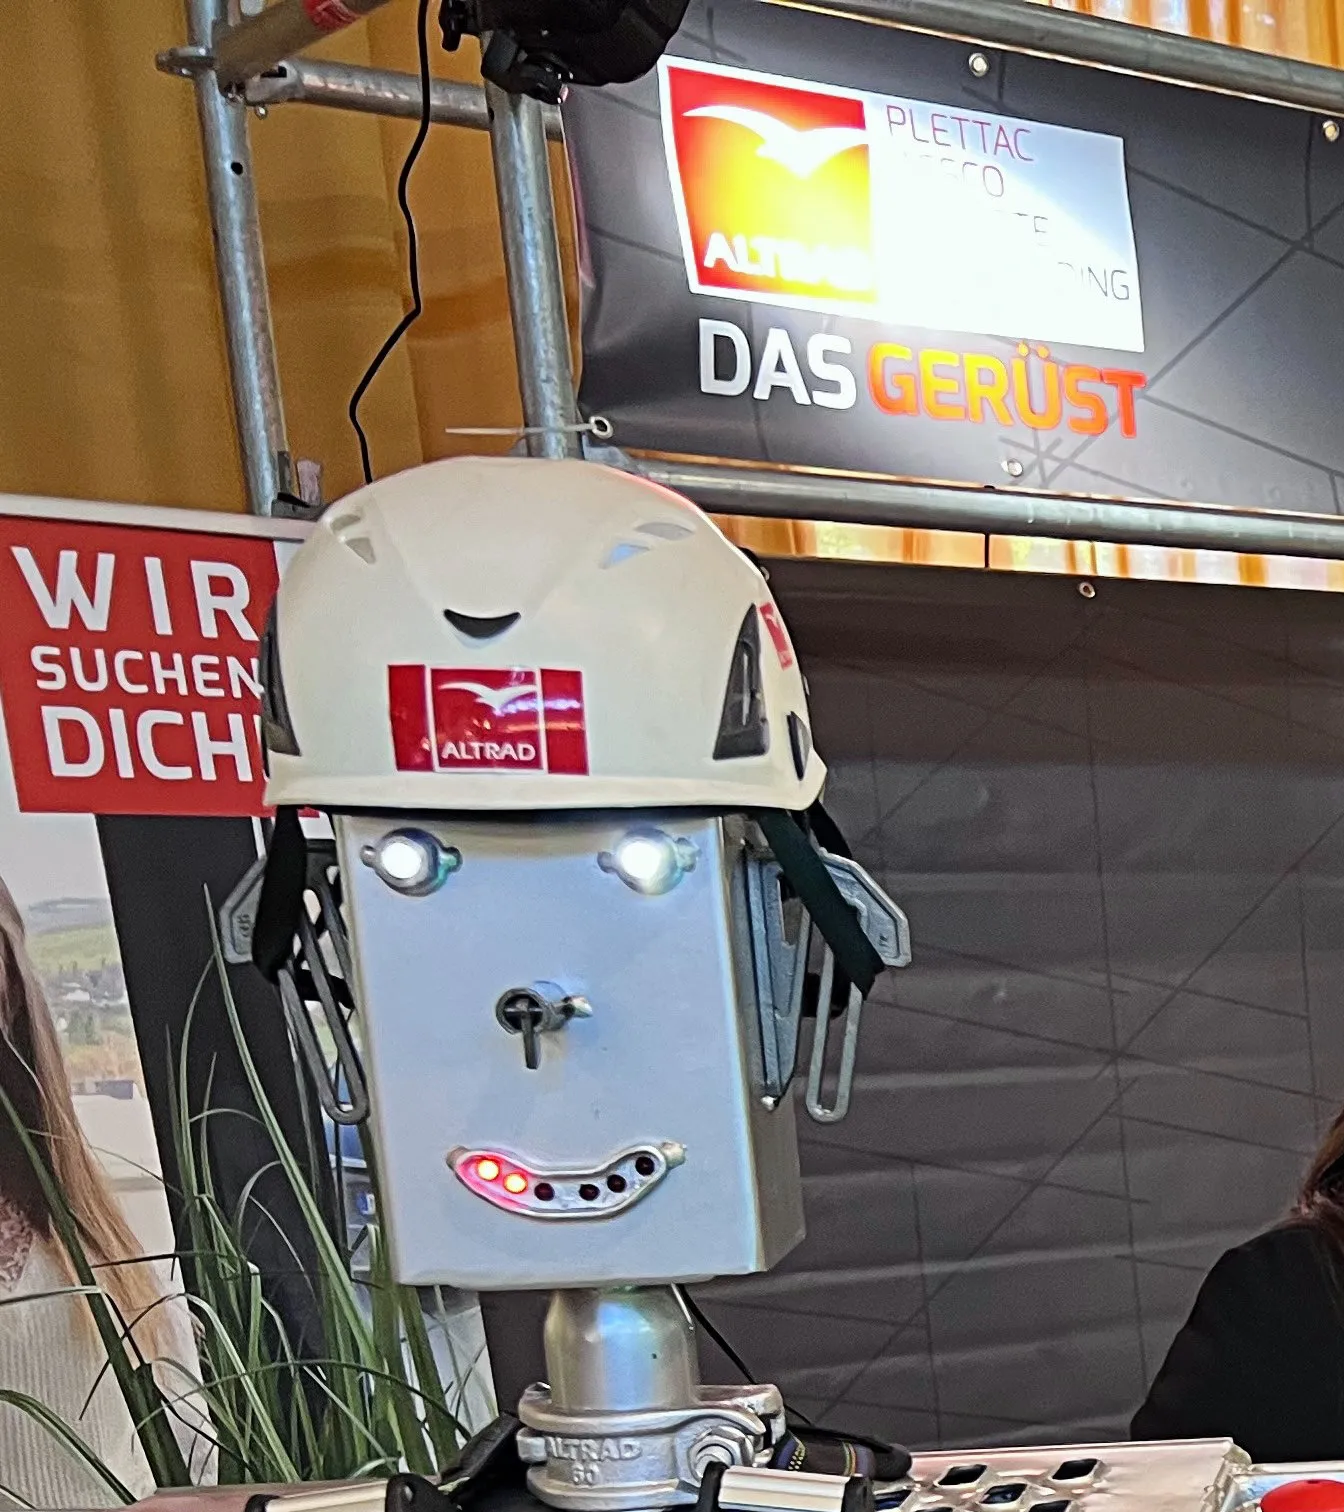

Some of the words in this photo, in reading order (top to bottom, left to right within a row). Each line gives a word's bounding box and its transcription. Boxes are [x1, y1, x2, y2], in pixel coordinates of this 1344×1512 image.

[887, 105, 1035, 161] PLETTAC
[700, 319, 856, 409] DAS
[867, 340, 1147, 439] GERÜST
[11, 545, 259, 641] WIR
[30, 645, 264, 699] SUCHEN
[441, 742, 536, 762] ALTRAD
